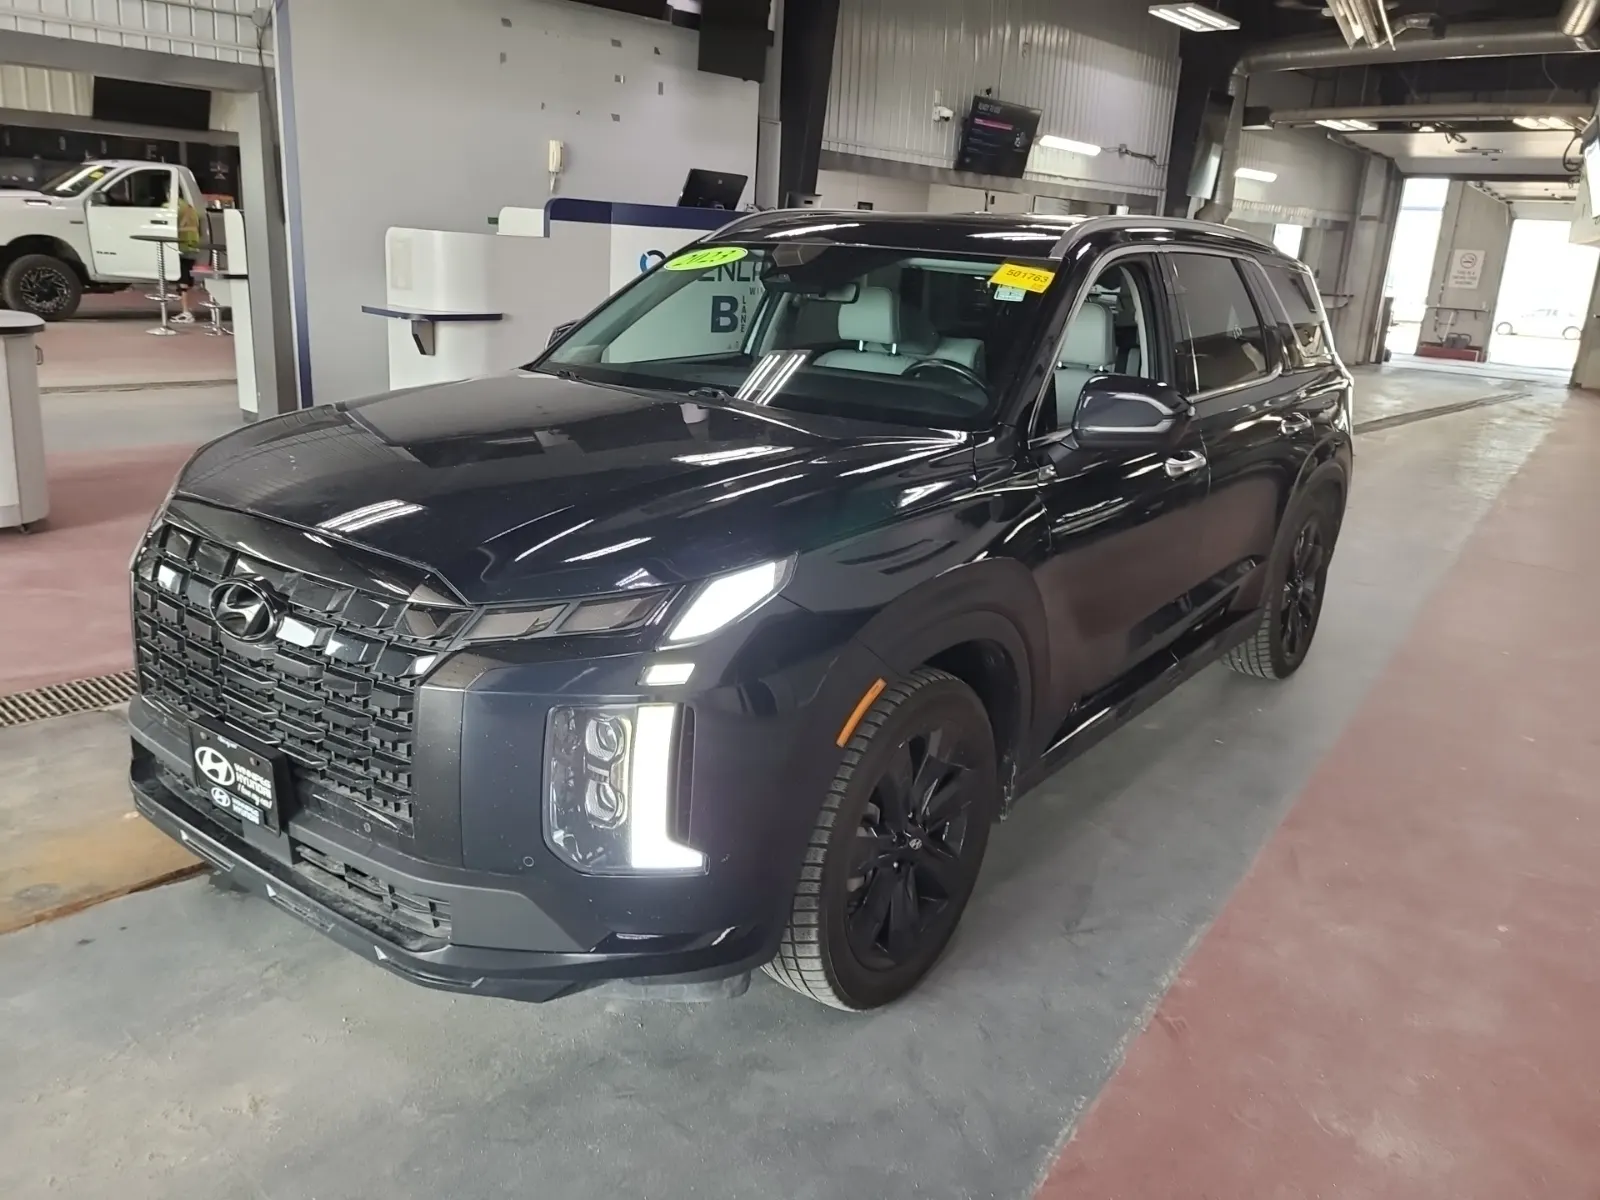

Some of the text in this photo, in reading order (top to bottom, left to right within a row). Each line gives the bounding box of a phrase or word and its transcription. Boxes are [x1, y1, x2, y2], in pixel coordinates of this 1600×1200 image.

[1006, 268, 1049, 283] 501763
[711, 295, 739, 333] B
[236, 771, 272, 799] HYUNDAI
